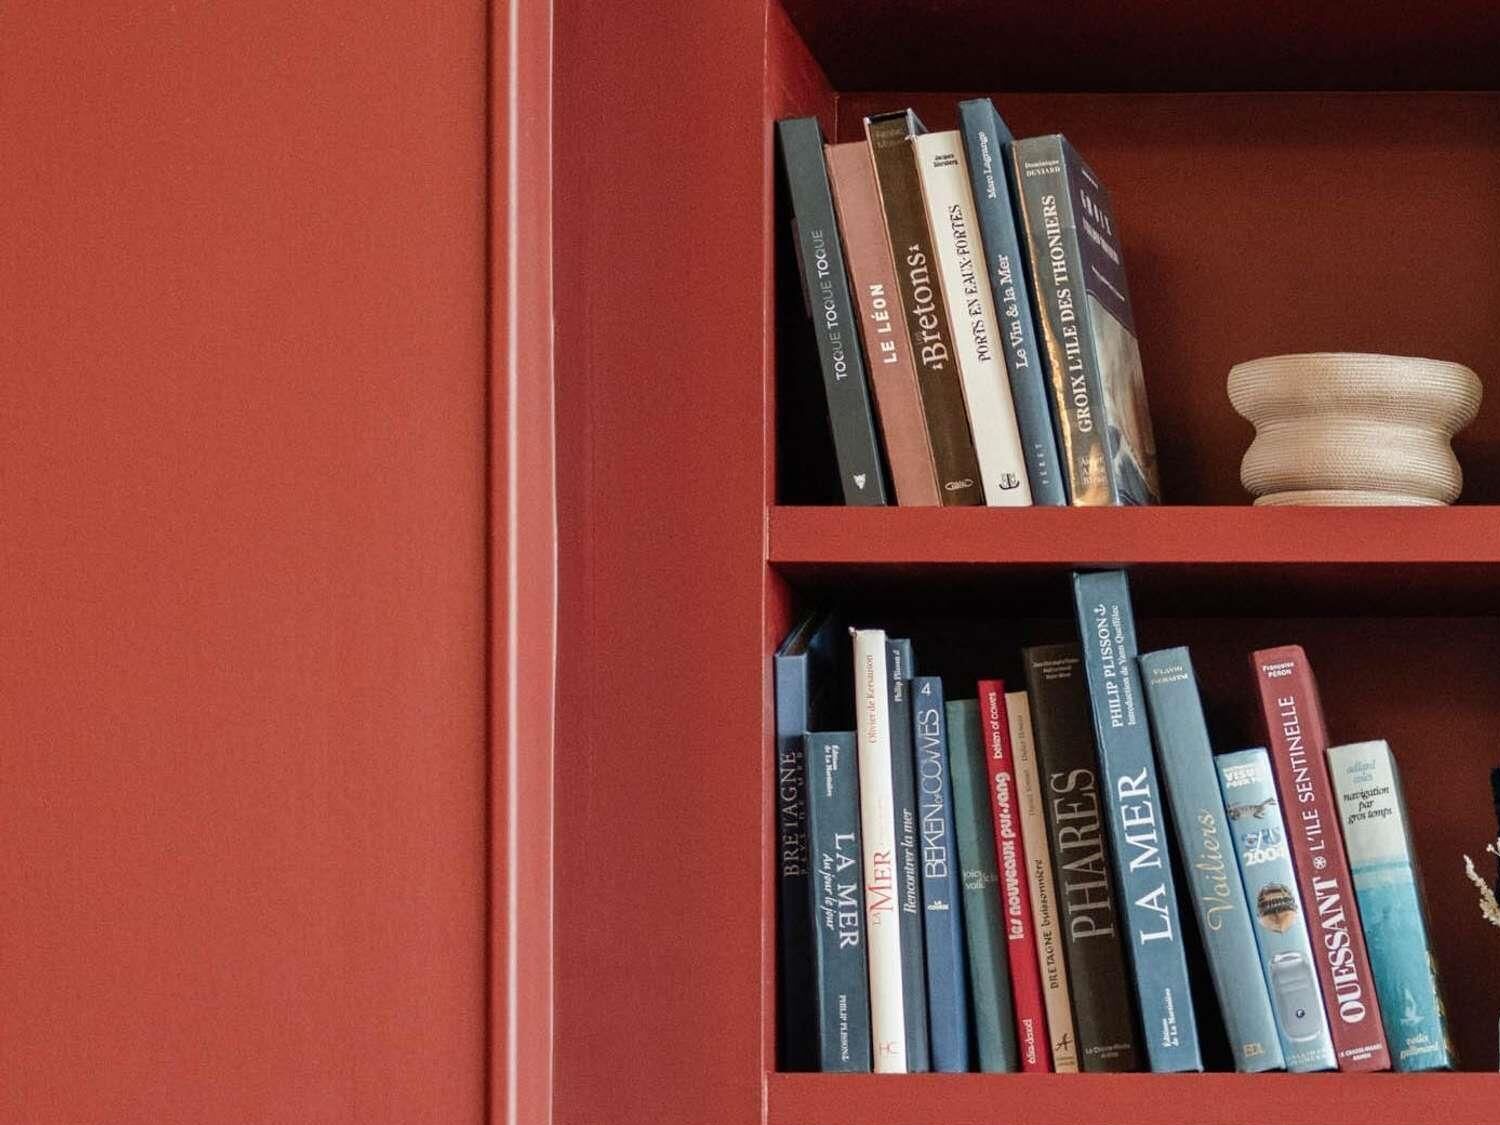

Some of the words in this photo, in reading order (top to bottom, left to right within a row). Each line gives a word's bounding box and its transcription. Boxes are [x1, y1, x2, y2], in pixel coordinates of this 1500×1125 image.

[983, 173, 997, 200] Marc
[811, 229, 830, 279] TOQUE
[1041, 194, 1069, 286] THONIERS
[997, 253, 1013, 286] Mer
[820, 280, 839, 330] TOQUE
[869, 284, 892, 334] LÉON
[907, 251, 949, 367] Bretons
[967, 297, 985, 318] EN
[1003, 286, 1017, 302] la
[1006, 305, 1019, 318] &
[1056, 288, 1075, 322] DES
[829, 331, 848, 381] TOQUE
[880, 339, 898, 364] LE
[970, 318, 992, 363] PORTS
[1009, 321, 1023, 347] Vin
[1015, 347, 1029, 369] Le
[1070, 374, 1093, 433] GROIX
[1095, 617, 1116, 678] PLISSON
[1118, 644, 1128, 666] Yann
[920, 682, 931, 695] 4
[1119, 665, 1129, 677] de
[988, 692, 999, 720] cowes
[1106, 681, 1124, 728] PHILIP
[1123, 676, 1137, 726] Introduction
[990, 720, 1000, 731] of
[993, 732, 1003, 759] beken
[919, 708, 943, 794] COWES
[1278, 695, 1316, 803] SENTINELLE
[780, 751, 800, 878] BRETAGNE
[1343, 786, 1390, 801] navigation
[1348, 812, 1366, 824] gros
[1367, 807, 1393, 819] temps
[1358, 800, 1375, 812] par
[900, 834, 913, 848] la
[903, 807, 913, 832] mer
[924, 804, 948, 878] BEKEN
[1117, 766, 1164, 873] MER
[1302, 808, 1325, 852] L'ILE
[822, 853, 835, 870] Au
[835, 832, 857, 873] LA
[1050, 769, 1116, 944] PHARES
[1195, 808, 1234, 930] Voiliers
[818, 869, 836, 896] jour
[865, 849, 894, 911] MER
[903, 847, 917, 915] Rencontrer
[1002, 840, 1022, 916] nouveaux
[820, 905, 837, 932] jour
[837, 882, 860, 950] MER
[1134, 883, 1174, 946] LA
[1043, 927, 1060, 990] BRETAGNE
[1312, 876, 1366, 1024] OUESSANT
